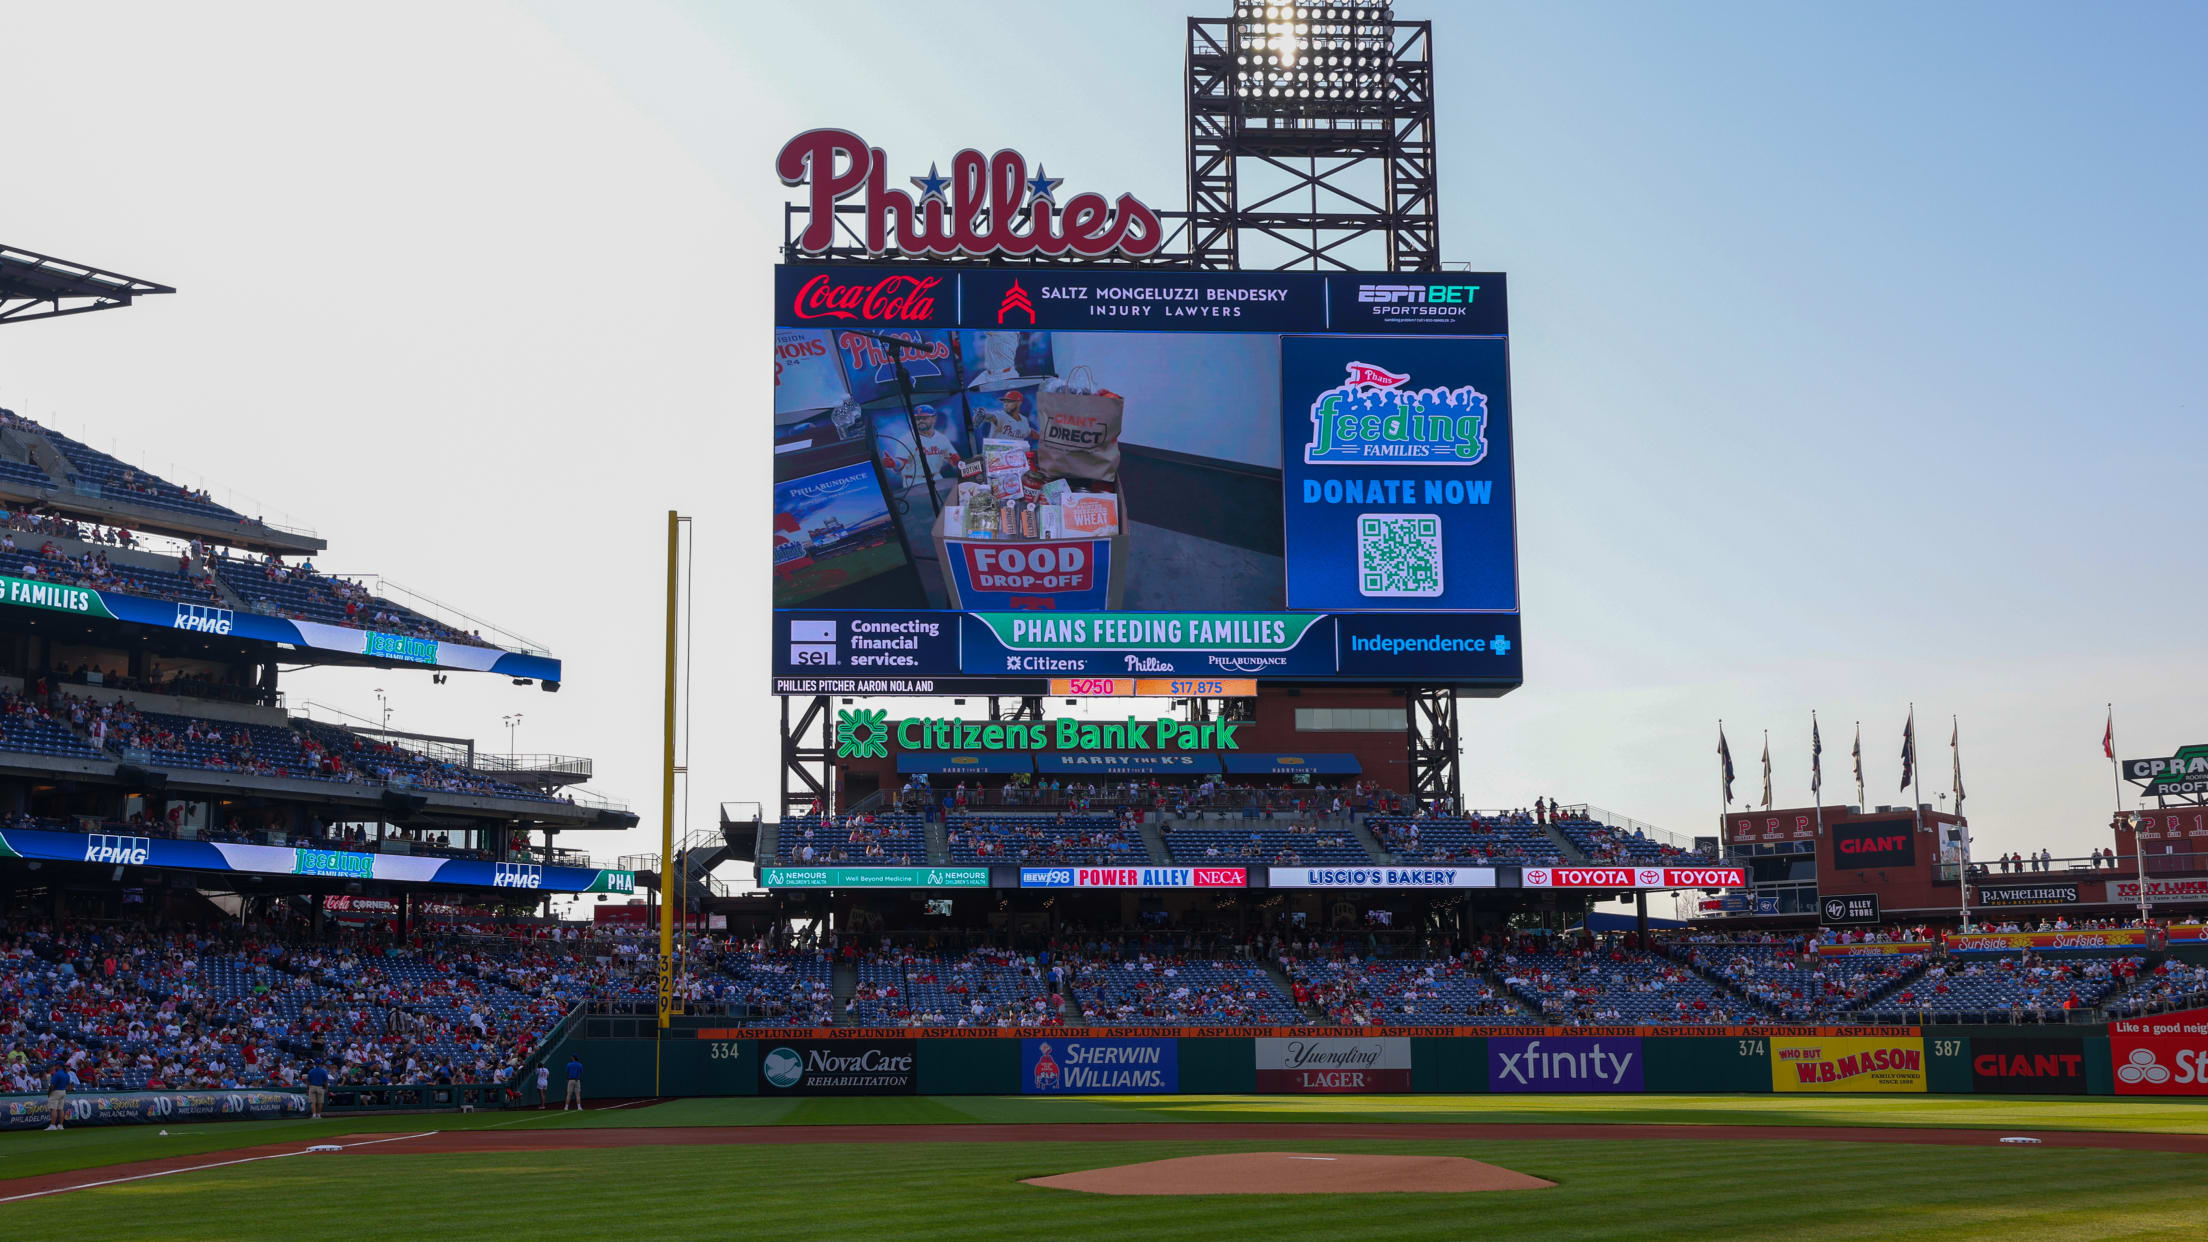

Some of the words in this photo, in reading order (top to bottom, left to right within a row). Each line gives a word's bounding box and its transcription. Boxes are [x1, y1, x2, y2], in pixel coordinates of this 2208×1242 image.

[776, 128, 1163, 258] Phillies
[794, 274, 943, 321] Coca-Cola
[1042, 286, 1088, 300] SALTZ
[1096, 286, 1199, 300] MONGELUZZI
[1207, 288, 1288, 302] BENDESKY
[1358, 284, 1426, 302] ESPN
[1428, 285, 1480, 303] BET
[1090, 305, 1151, 316] INJURY
[1166, 306, 1241, 317] LAWYERS
[1372, 306, 1466, 315] SPORTSBOOK
[1365, 369, 1392, 384] Phans
[1054, 414, 1097, 428] GIANT
[1312, 396, 1481, 458] feeding
[1363, 444, 1430, 456] FAMILIES
[1303, 479, 1416, 504] DONATE
[1424, 480, 1492, 504] NOW
[974, 548, 1084, 573] FOOD
[980, 574, 1084, 588] DROP-OFF
[11, 580, 88, 611] FAMILIES
[174, 614, 232, 634] KPMG
[851, 620, 940, 636] Connecting
[1014, 620, 1086, 643] PHANS
[1094, 620, 1182, 643] FEEDING
[1189, 620, 1286, 644] FAMILIES
[851, 636, 918, 650] financial
[1352, 634, 1486, 655] Independence
[851, 652, 918, 666] services.
[1024, 656, 1084, 670] Citizens
[1124, 655, 1174, 672] Phillies
[1208, 656, 1287, 668] PHILABUNDANCE
[777, 680, 816, 692] PHILLIES
[818, 680, 854, 692] PITCHER
[857, 681, 888, 692] AARON
[890, 681, 914, 692] NOLA
[915, 681, 934, 692] AND
[1170, 681, 1223, 695] $17,875
[898, 716, 1046, 750] Citizens
[1056, 715, 1150, 750] Bank
[1156, 715, 1240, 750] Park
[1062, 756, 1129, 764] HARRY
[2134, 761, 2166, 776] CP
[1738, 820, 1751, 836] P
[1766, 818, 1780, 834] P
[1796, 816, 1808, 832] P
[1840, 836, 1907, 854] GIANT
[84, 846, 147, 864] KPMG
[492, 872, 540, 888] KPMG
[608, 874, 632, 890] PHA
[786, 872, 826, 880] NEMOURS
[860, 875, 883, 883] Beyond
[946, 872, 986, 880] NEMOURS
[1080, 870, 1138, 886] POWER
[1143, 870, 1190, 886] ALLEY
[1198, 872, 1244, 884] NECA
[1308, 870, 1382, 885] LISCIO'S
[1388, 870, 1456, 885] BAKERY
[1559, 872, 1628, 884] TOYOTA
[1671, 872, 1740, 884] TOYOTA
[2117, 882, 2160, 891] TOY
[352, 899, 390, 910] CORNER
[1850, 900, 1871, 908] ALLEY
[1850, 909, 1874, 917] STORE
[1958, 936, 2006, 950] Surfside
[2053, 934, 2104, 948] Surfside
[736, 1029, 813, 1038] ASPLUNDH
[828, 1029, 906, 1038] ASPLUNDH
[922, 1028, 998, 1038] ASPLUNDH
[1014, 1028, 1090, 1037] ASPLUNDH
[1106, 1028, 1182, 1037] ASPLUNDH
[1198, 1028, 1272, 1036] ASPLUNDH
[1288, 1028, 1364, 1036] ASPLUNDH
[1379, 1028, 1454, 1036] ASPLUNDH
[1470, 1028, 1545, 1036] ASPLUNDH
[1560, 1028, 1636, 1036] ASPLUNDH
[1650, 1028, 1726, 1036] ASPLUNDH
[1742, 1028, 1817, 1036] ASPLUNDH
[1834, 1028, 1910, 1036] ASPLUNDH
[2116, 1022, 2140, 1032] Like
[2154, 1023, 2180, 1035] good
[711, 1042, 739, 1059] 334
[1064, 1043, 1160, 1064] SHERWIN
[1284, 1042, 1382, 1068] Yuengling
[1739, 1040, 1764, 1056] 374
[1778, 1050, 1801, 1060] WHO
[1802, 1048, 1822, 1059] BUT
[1934, 1040, 1960, 1056] 387
[806, 1050, 912, 1072] NovaCare
[1498, 1041, 1633, 1084] xfinity
[1974, 1054, 2082, 1077] GIANT
[806, 1076, 908, 1086] REHABILITATION
[1303, 1072, 1364, 1088] LAGER
[72, 1100, 92, 1120] 10
[111, 1098, 139, 1110] Sports
[154, 1096, 172, 1116] 10
[228, 1094, 244, 1112] 10
[100, 1110, 138, 1118] PHILADELPHIA
